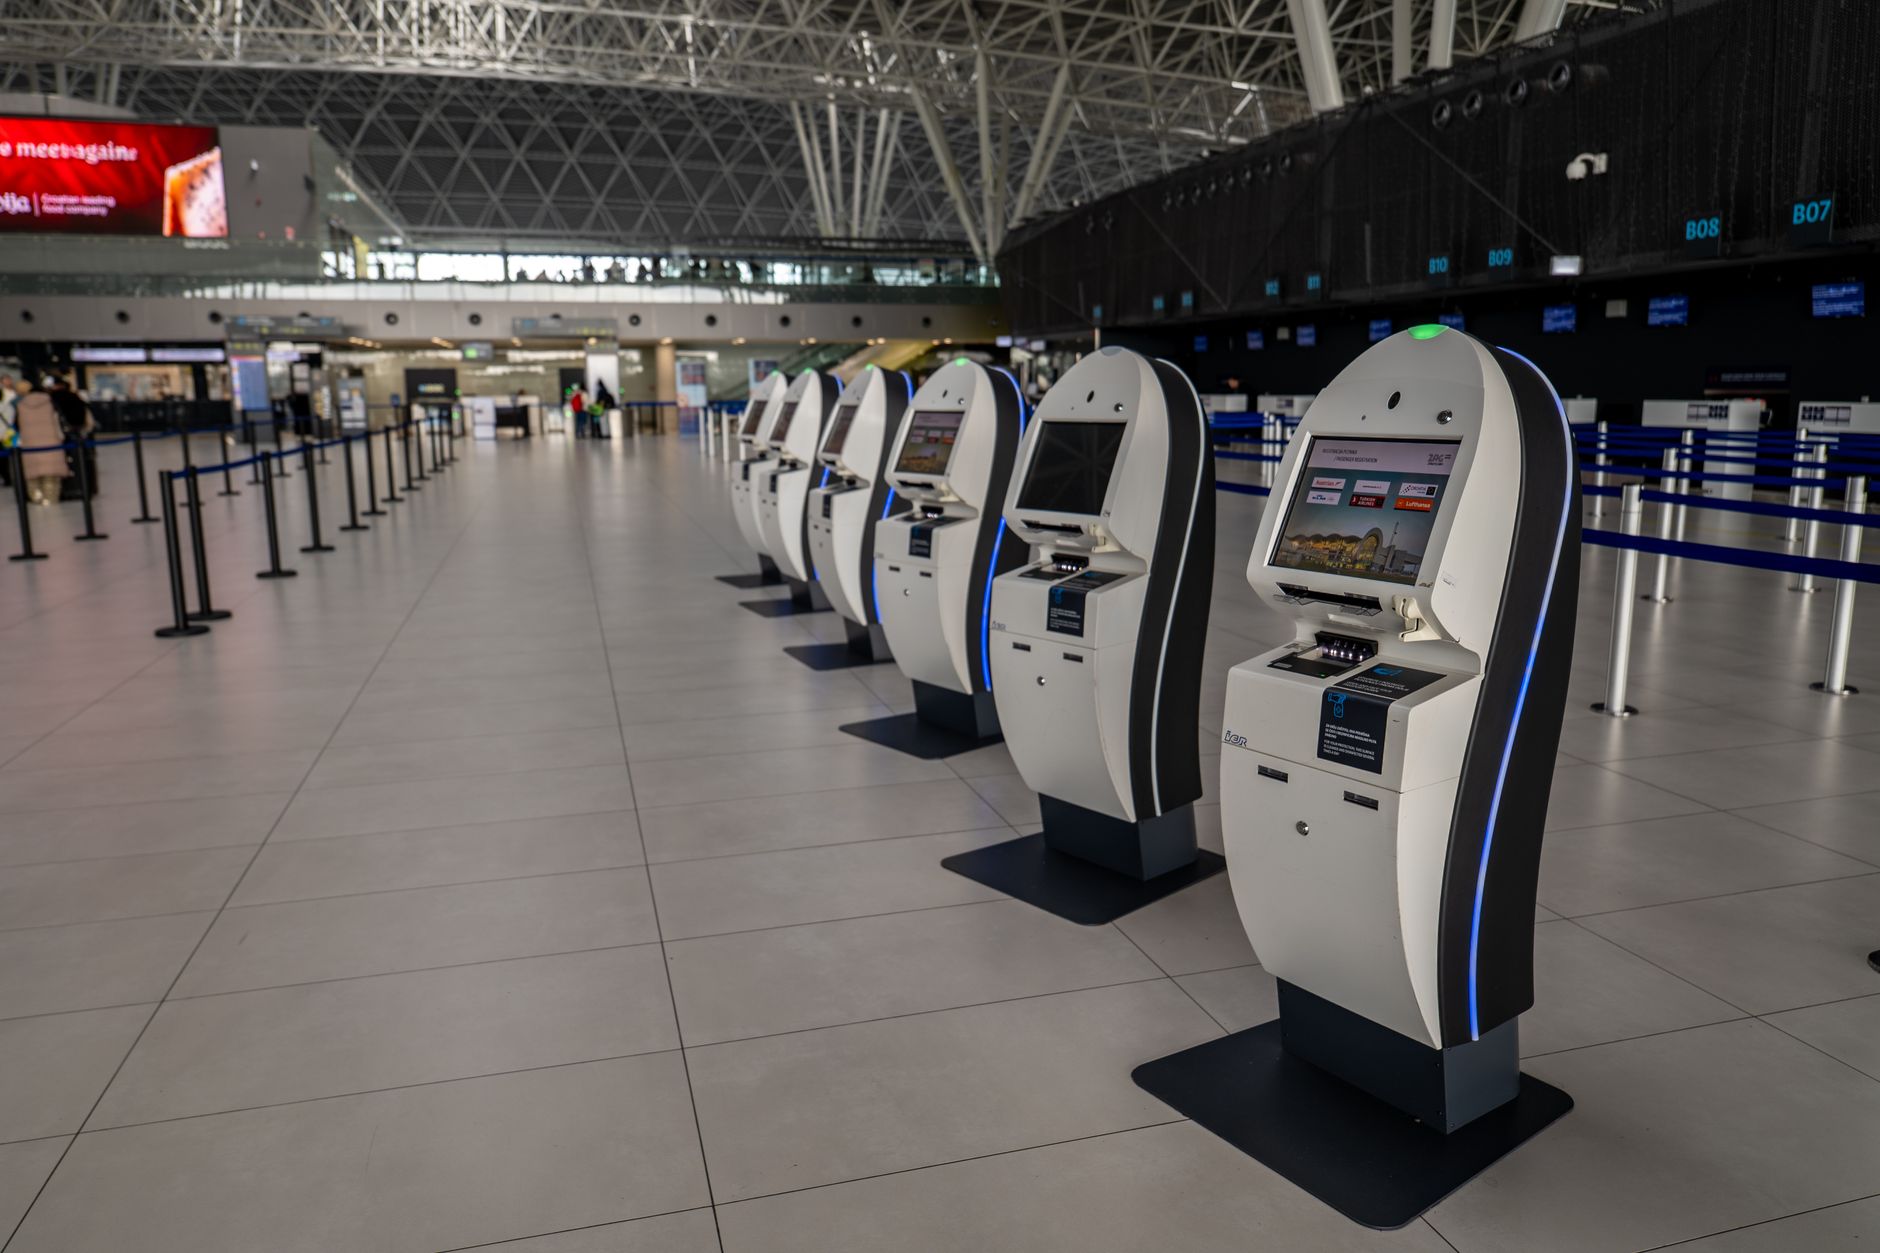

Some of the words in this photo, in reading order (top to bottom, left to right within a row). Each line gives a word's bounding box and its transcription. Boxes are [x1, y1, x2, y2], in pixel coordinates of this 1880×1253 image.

[1792, 199, 1831, 225] B07
[1686, 217, 1719, 240] B08
[1429, 257, 1448, 274] B10
[1488, 248, 1512, 267] B09
